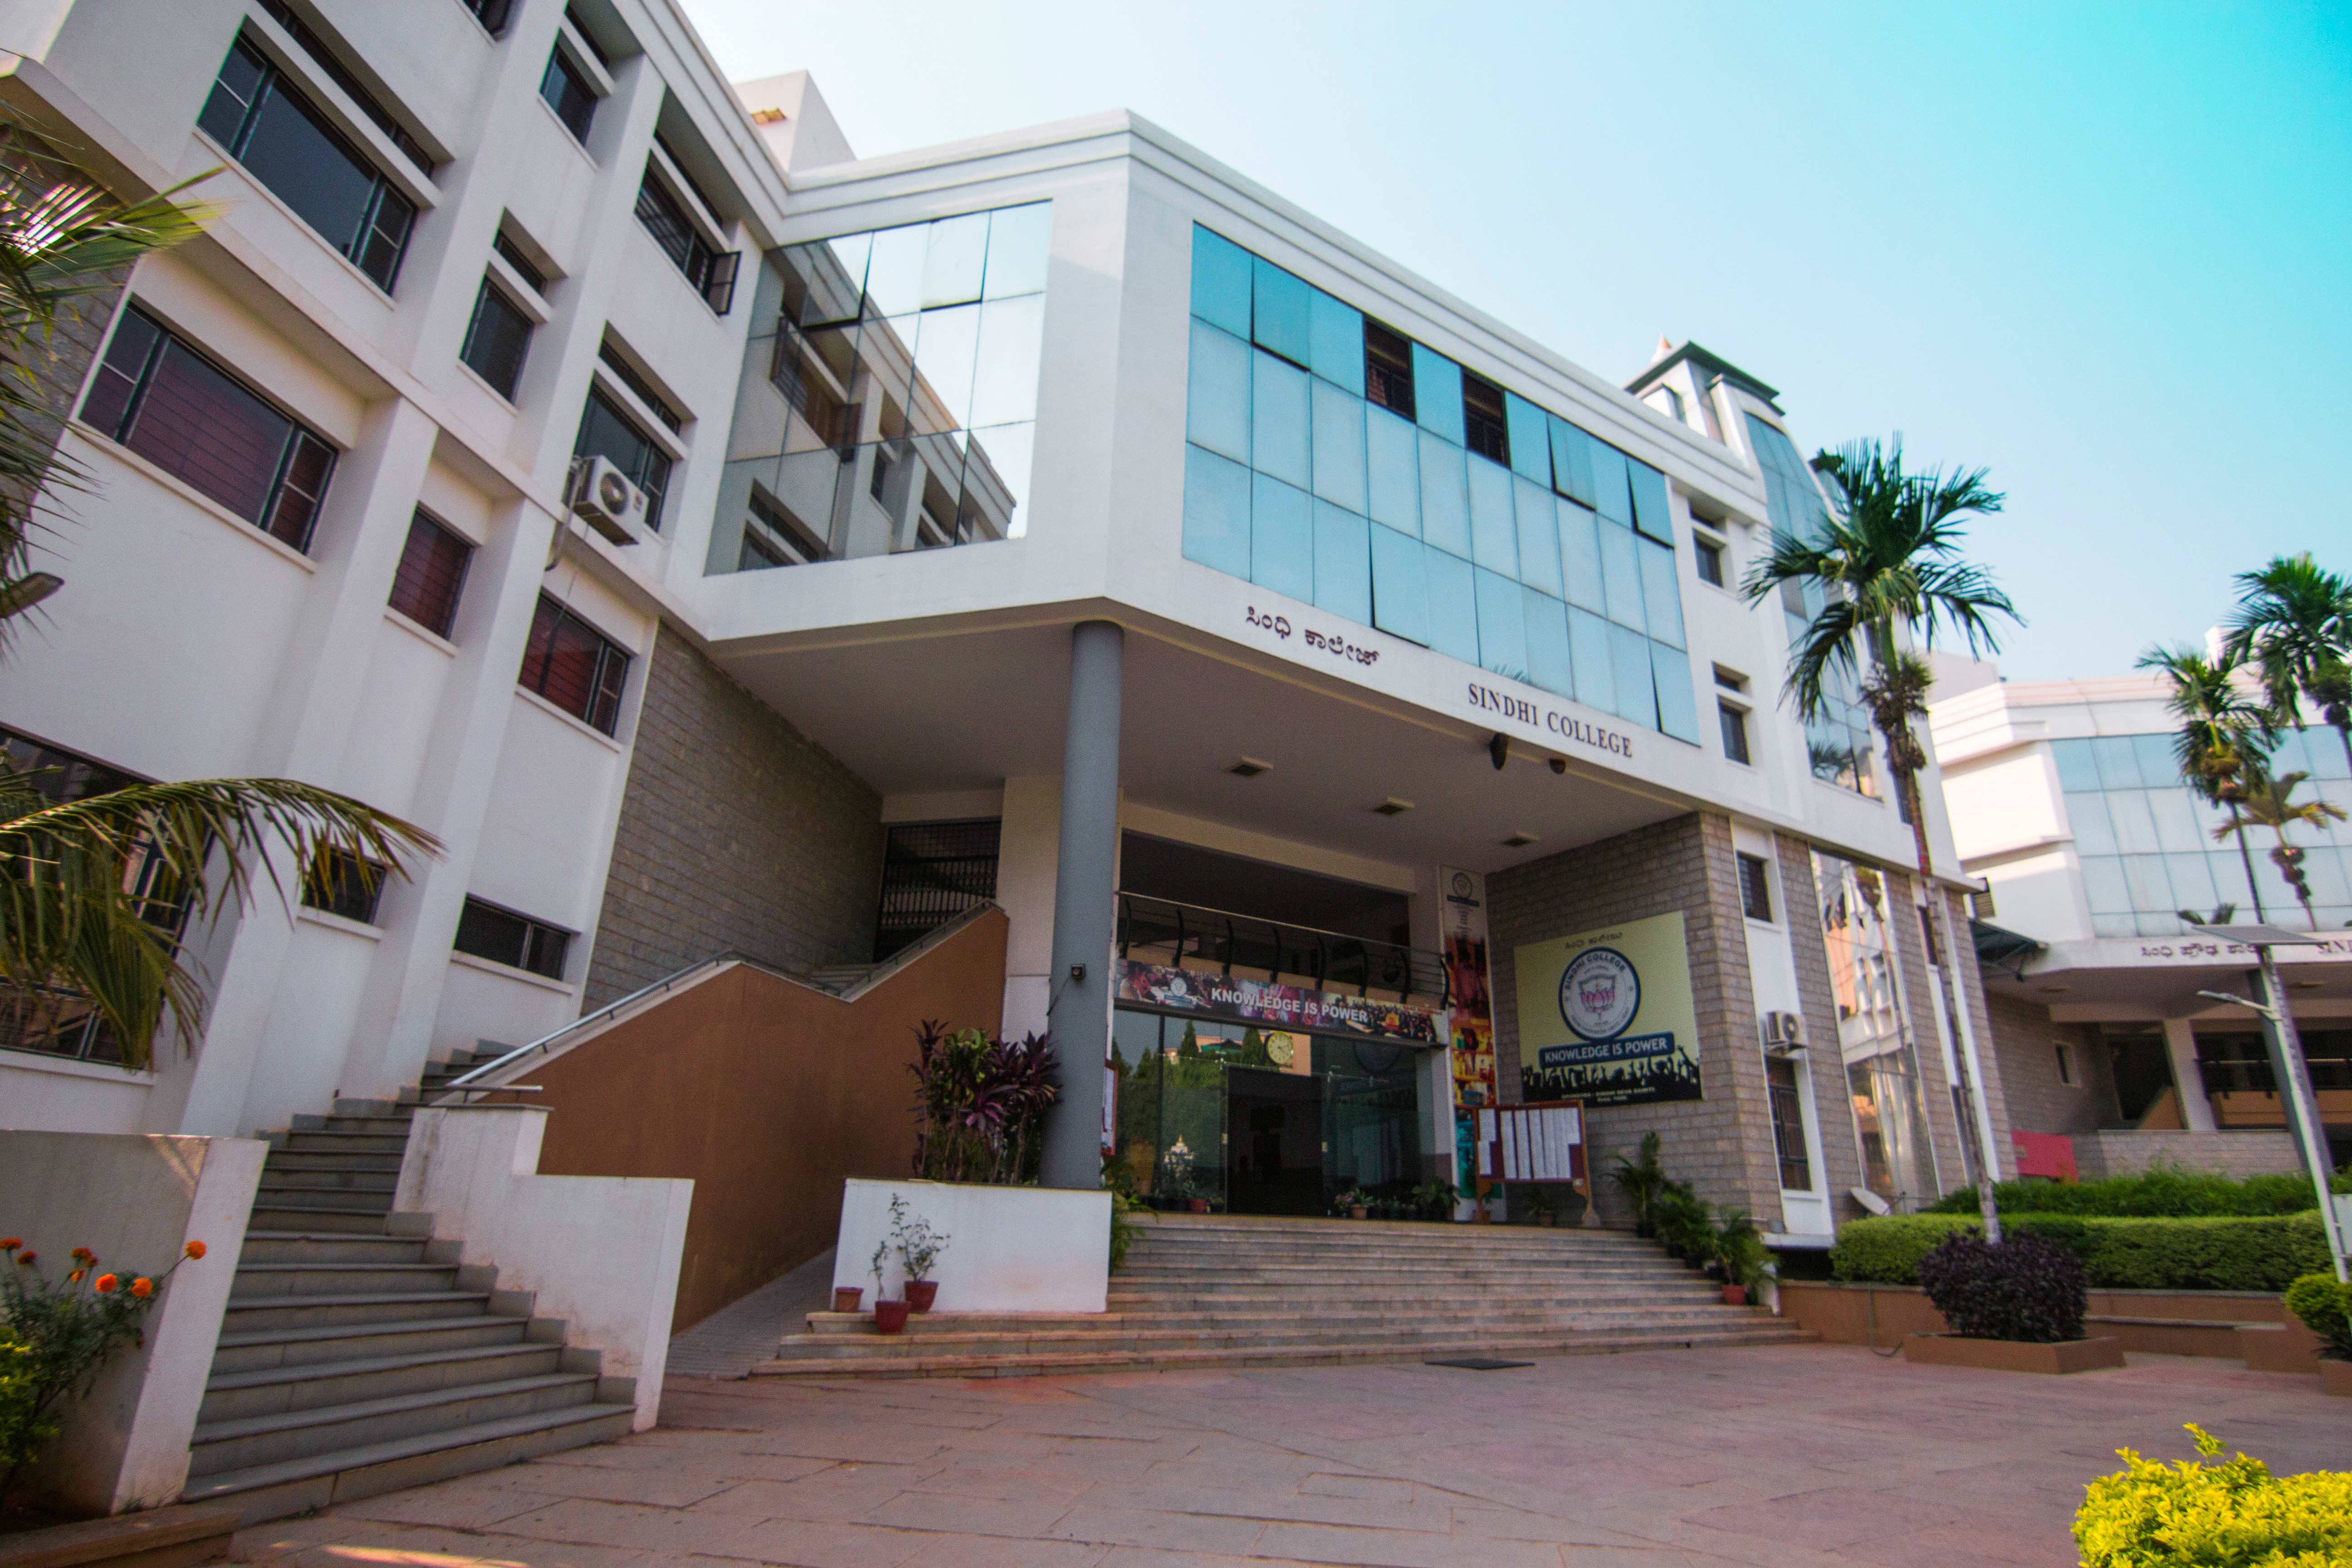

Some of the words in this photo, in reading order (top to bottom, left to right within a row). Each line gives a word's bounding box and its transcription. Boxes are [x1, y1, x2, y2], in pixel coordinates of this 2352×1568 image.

[1246, 606, 1291, 640] ಸಿಂಧಿ
[1305, 629, 1379, 666] ಕಾಲೇಜ್
[1469, 683, 1539, 726] SINDHI
[1547, 711, 1632, 758] COLLEGE
[1565, 959, 1586, 990] SINDHI
[1587, 953, 1626, 972] COLLEGE
[1211, 988, 1301, 1013] KNOWLEDGE
[1305, 1002, 1317, 1015] IS
[1322, 1004, 1369, 1023] POWER
[1544, 1044, 1610, 1063] KNOWLEDGE
[1612, 1044, 1623, 1056] IS
[1625, 1037, 1667, 1054] POWER
